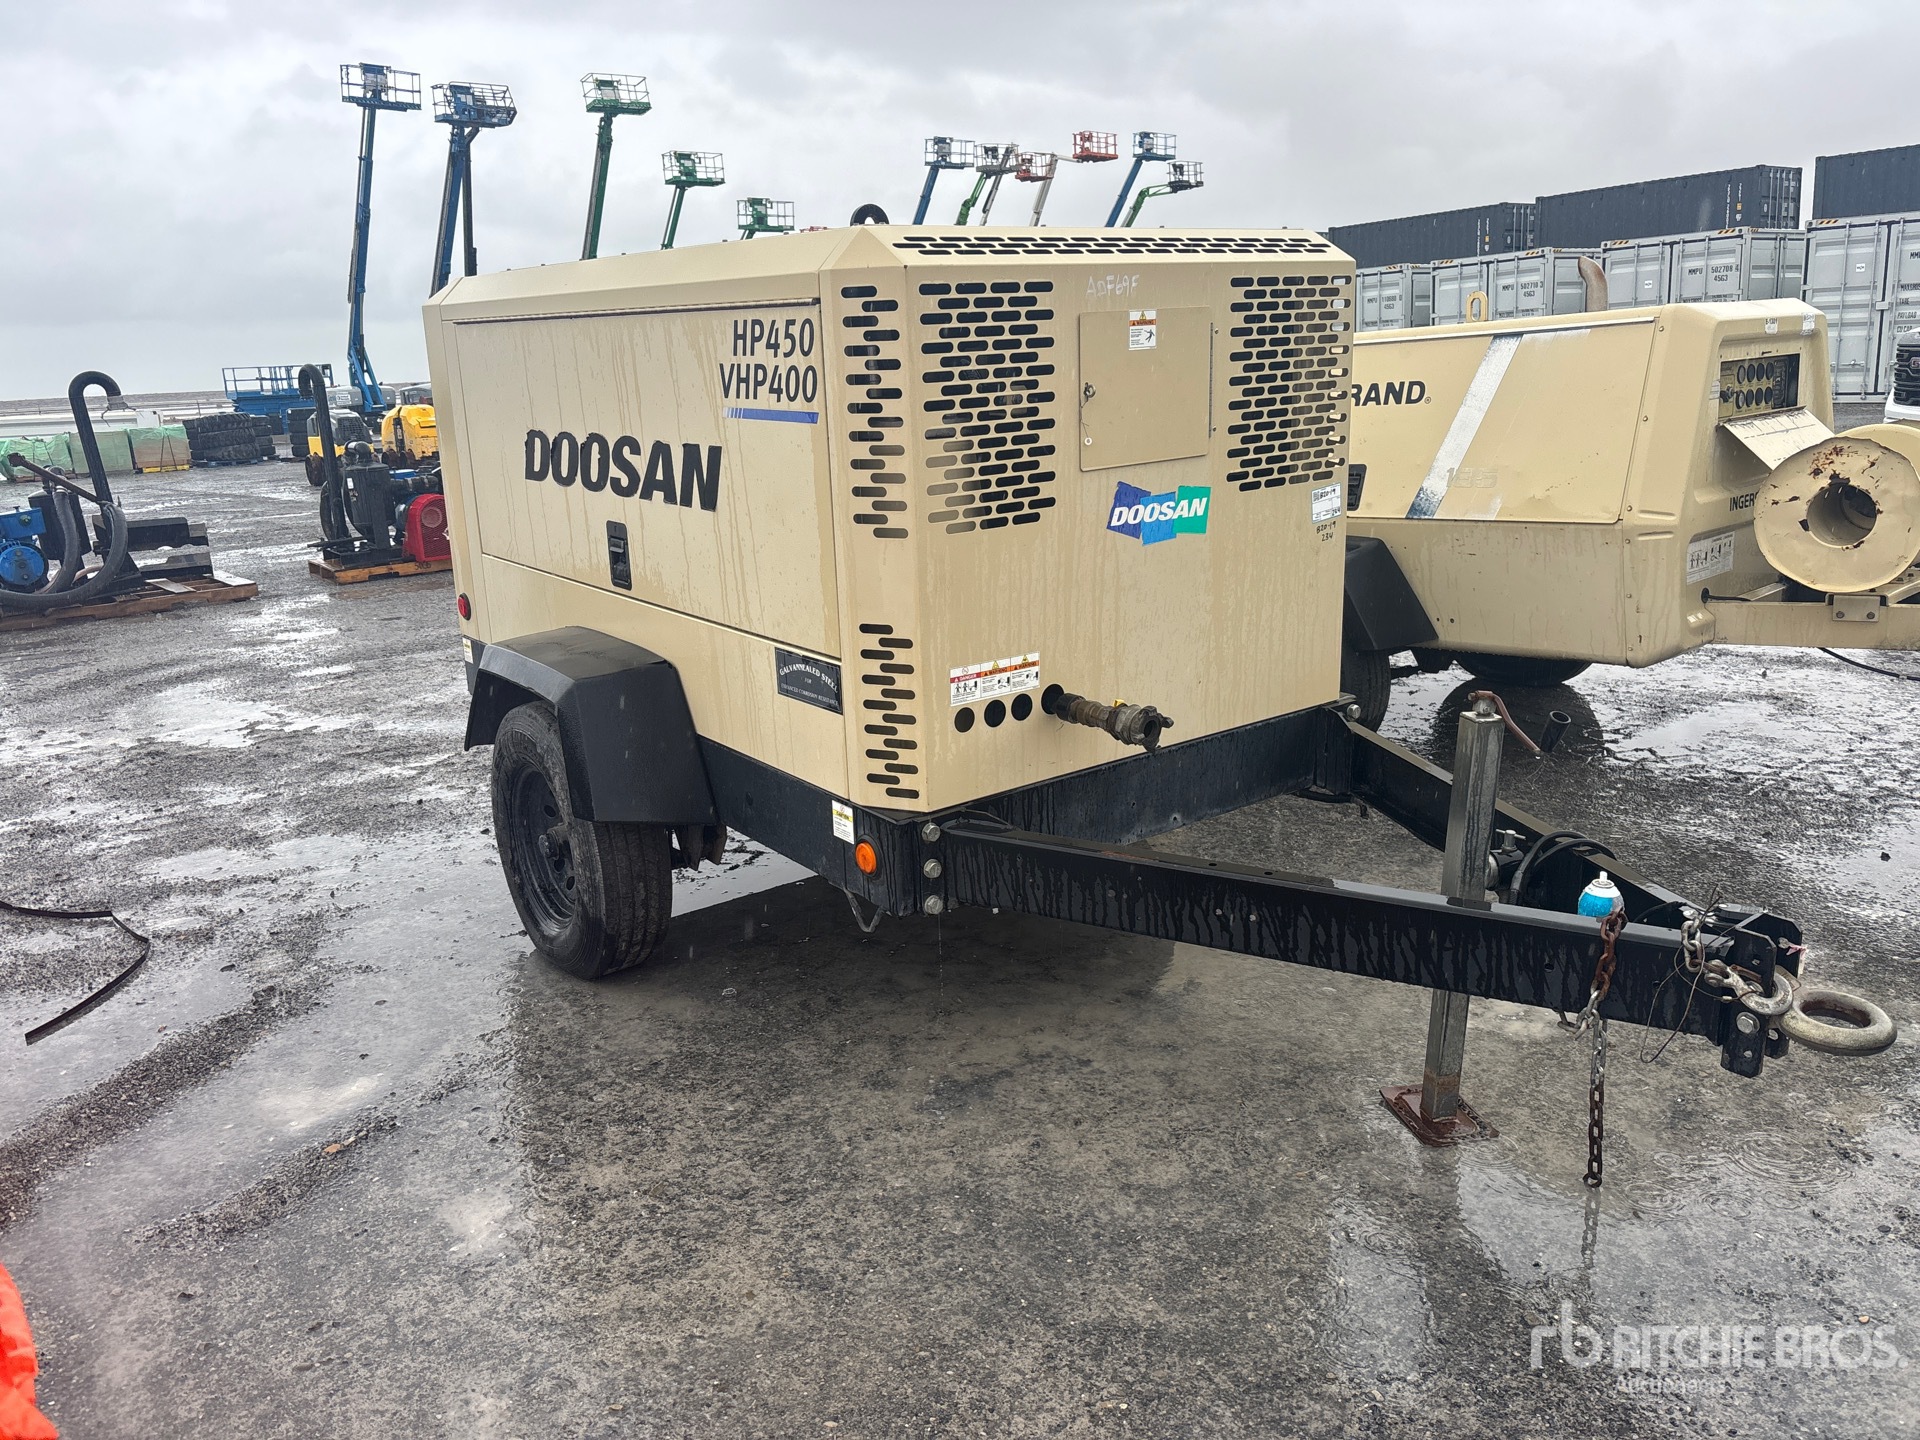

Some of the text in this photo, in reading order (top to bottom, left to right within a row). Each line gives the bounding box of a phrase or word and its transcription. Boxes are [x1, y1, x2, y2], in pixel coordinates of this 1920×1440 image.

[1711, 266, 1733, 274] 502708
[732, 318, 815, 358] HP450
[719, 362, 818, 403] VHP400
[525, 429, 722, 512] DOOSAN
[1110, 497, 1208, 527] DOOSAN
[1729, 490, 1759, 511] INGER
[821, 673, 838, 693] STEEL
[960, 673, 977, 681] DANGER
